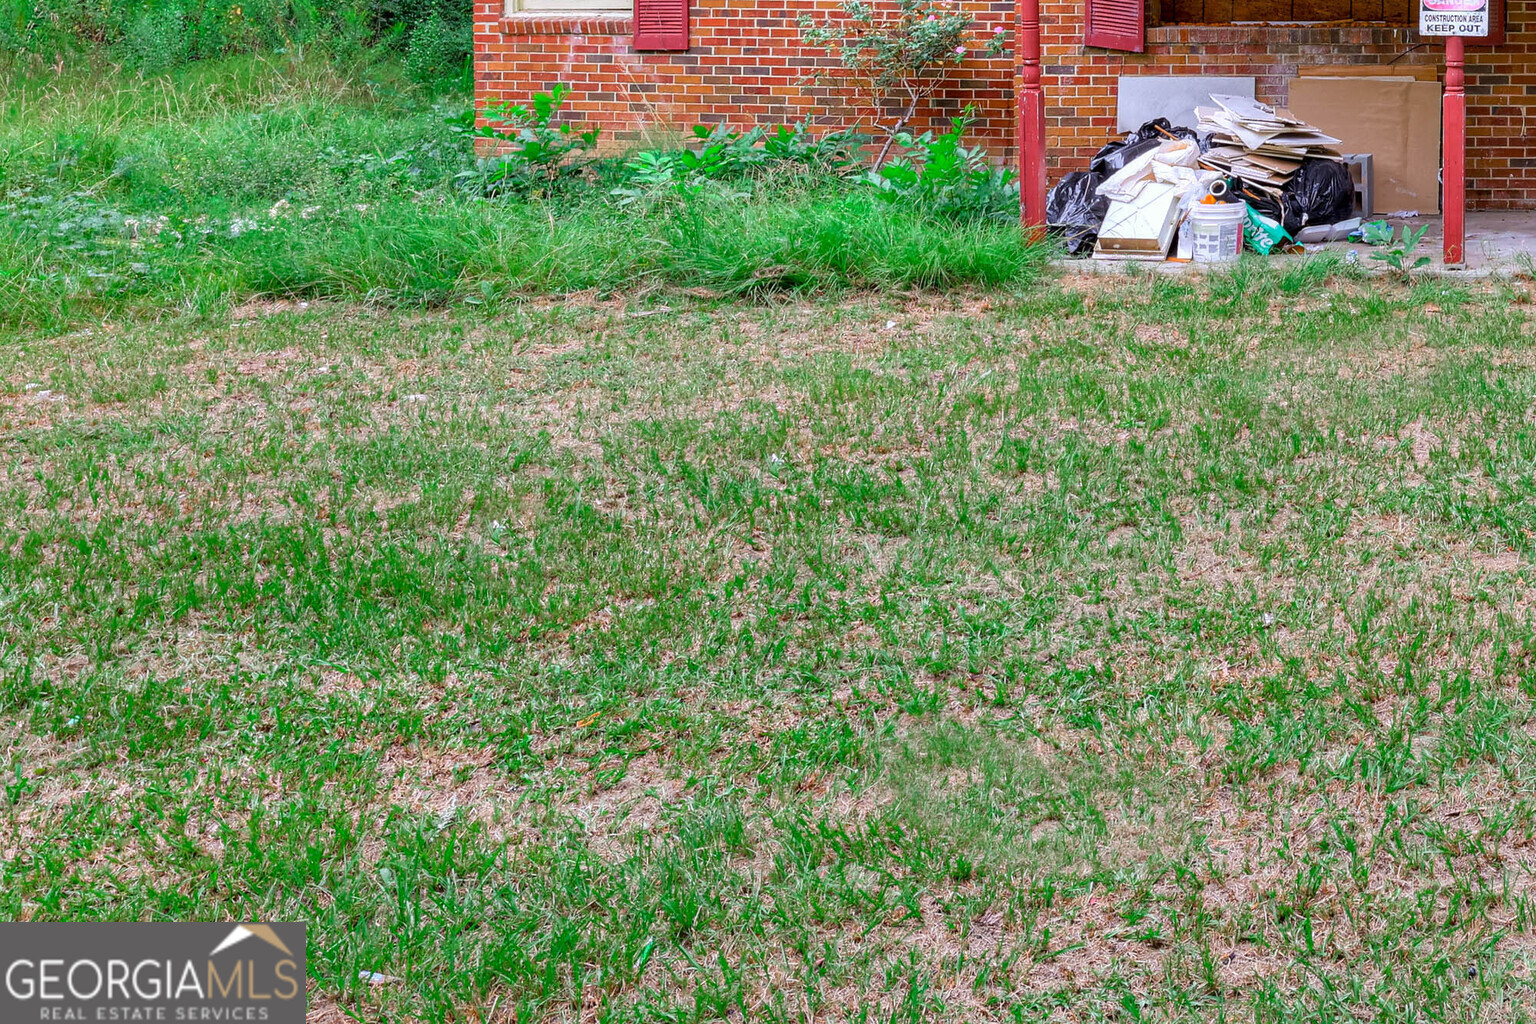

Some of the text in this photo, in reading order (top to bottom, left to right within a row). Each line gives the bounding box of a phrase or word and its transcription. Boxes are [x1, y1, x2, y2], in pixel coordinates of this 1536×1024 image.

[1424, 14, 1484, 23] CONSTRUCTION AREA
[1426, 24, 1481, 32] KEEP OUT
[1243, 211, 1274, 248] prite
